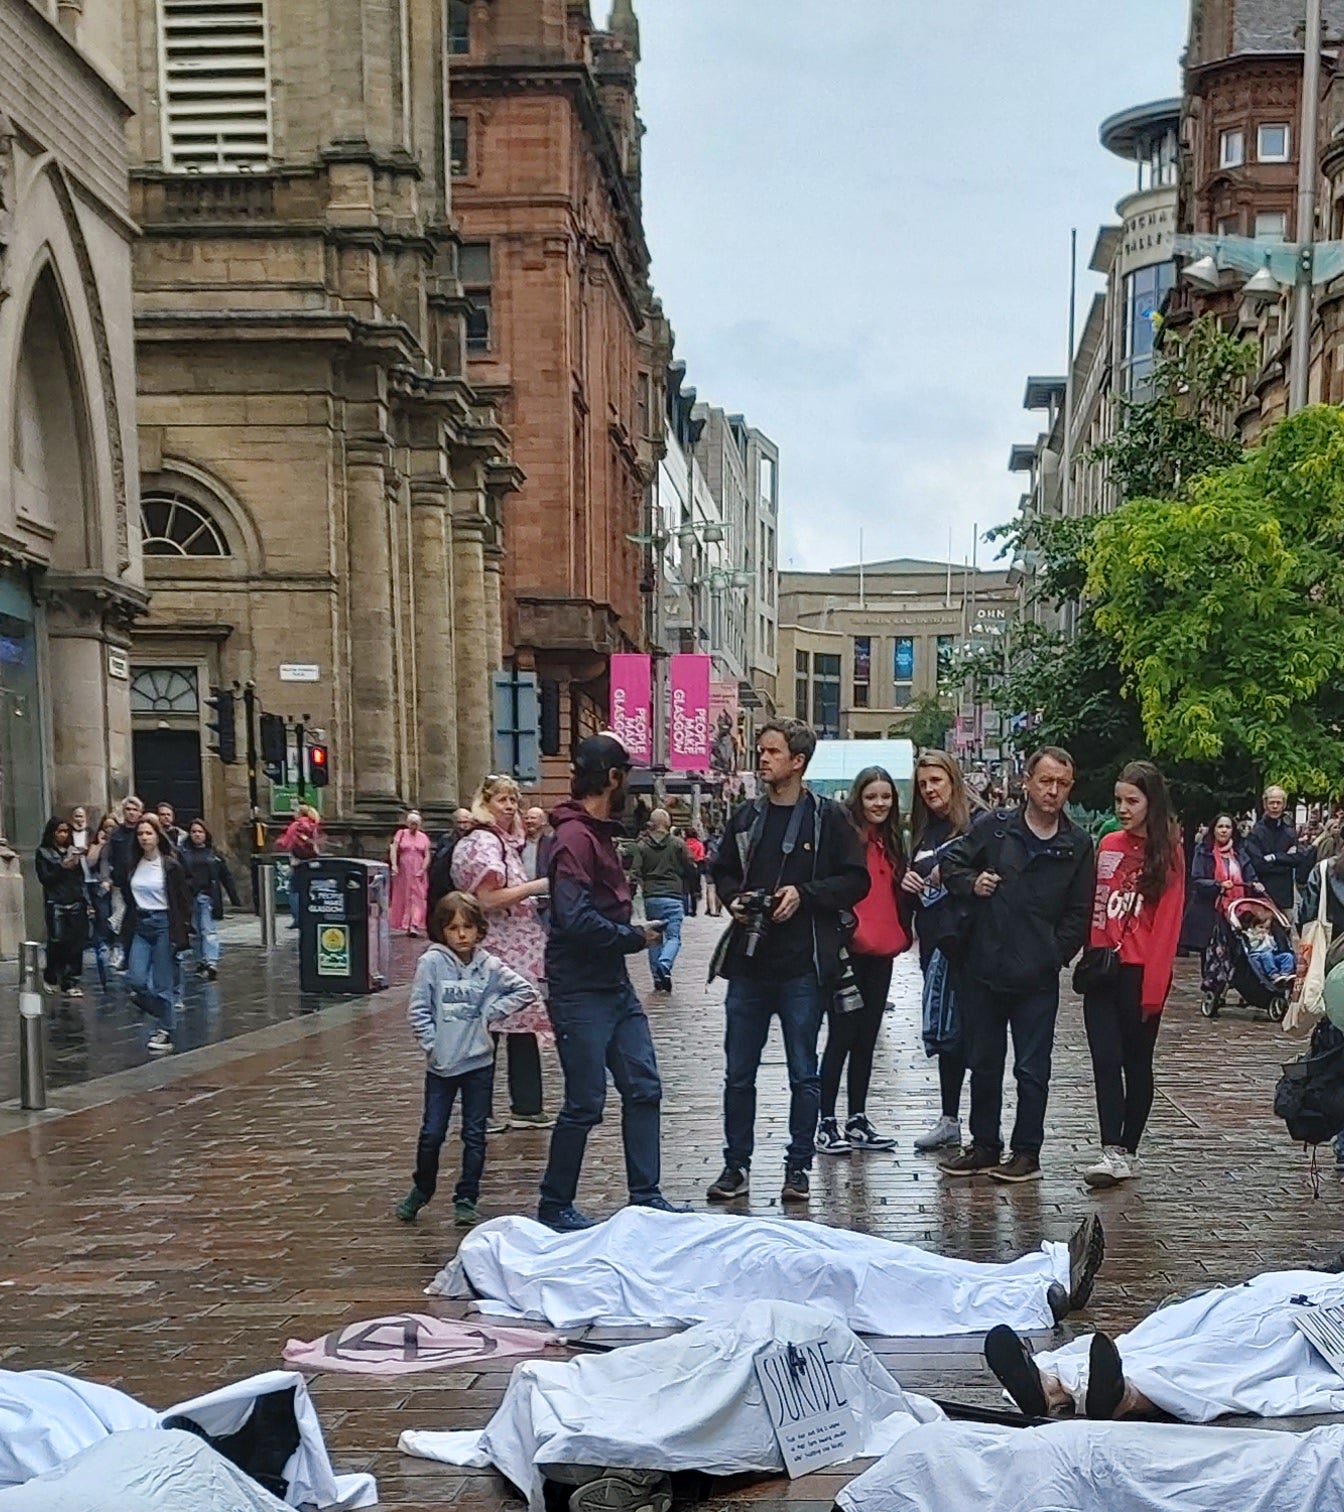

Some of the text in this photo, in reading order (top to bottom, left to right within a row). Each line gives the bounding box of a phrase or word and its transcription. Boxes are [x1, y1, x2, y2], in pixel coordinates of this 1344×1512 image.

[614, 688, 627, 741] GLASGO
[635, 707, 648, 754] PEOPLE
[673, 689, 686, 754] GLASGOW
[684, 717, 695, 754] MAKE
[694, 707, 707, 755] PEOPLE
